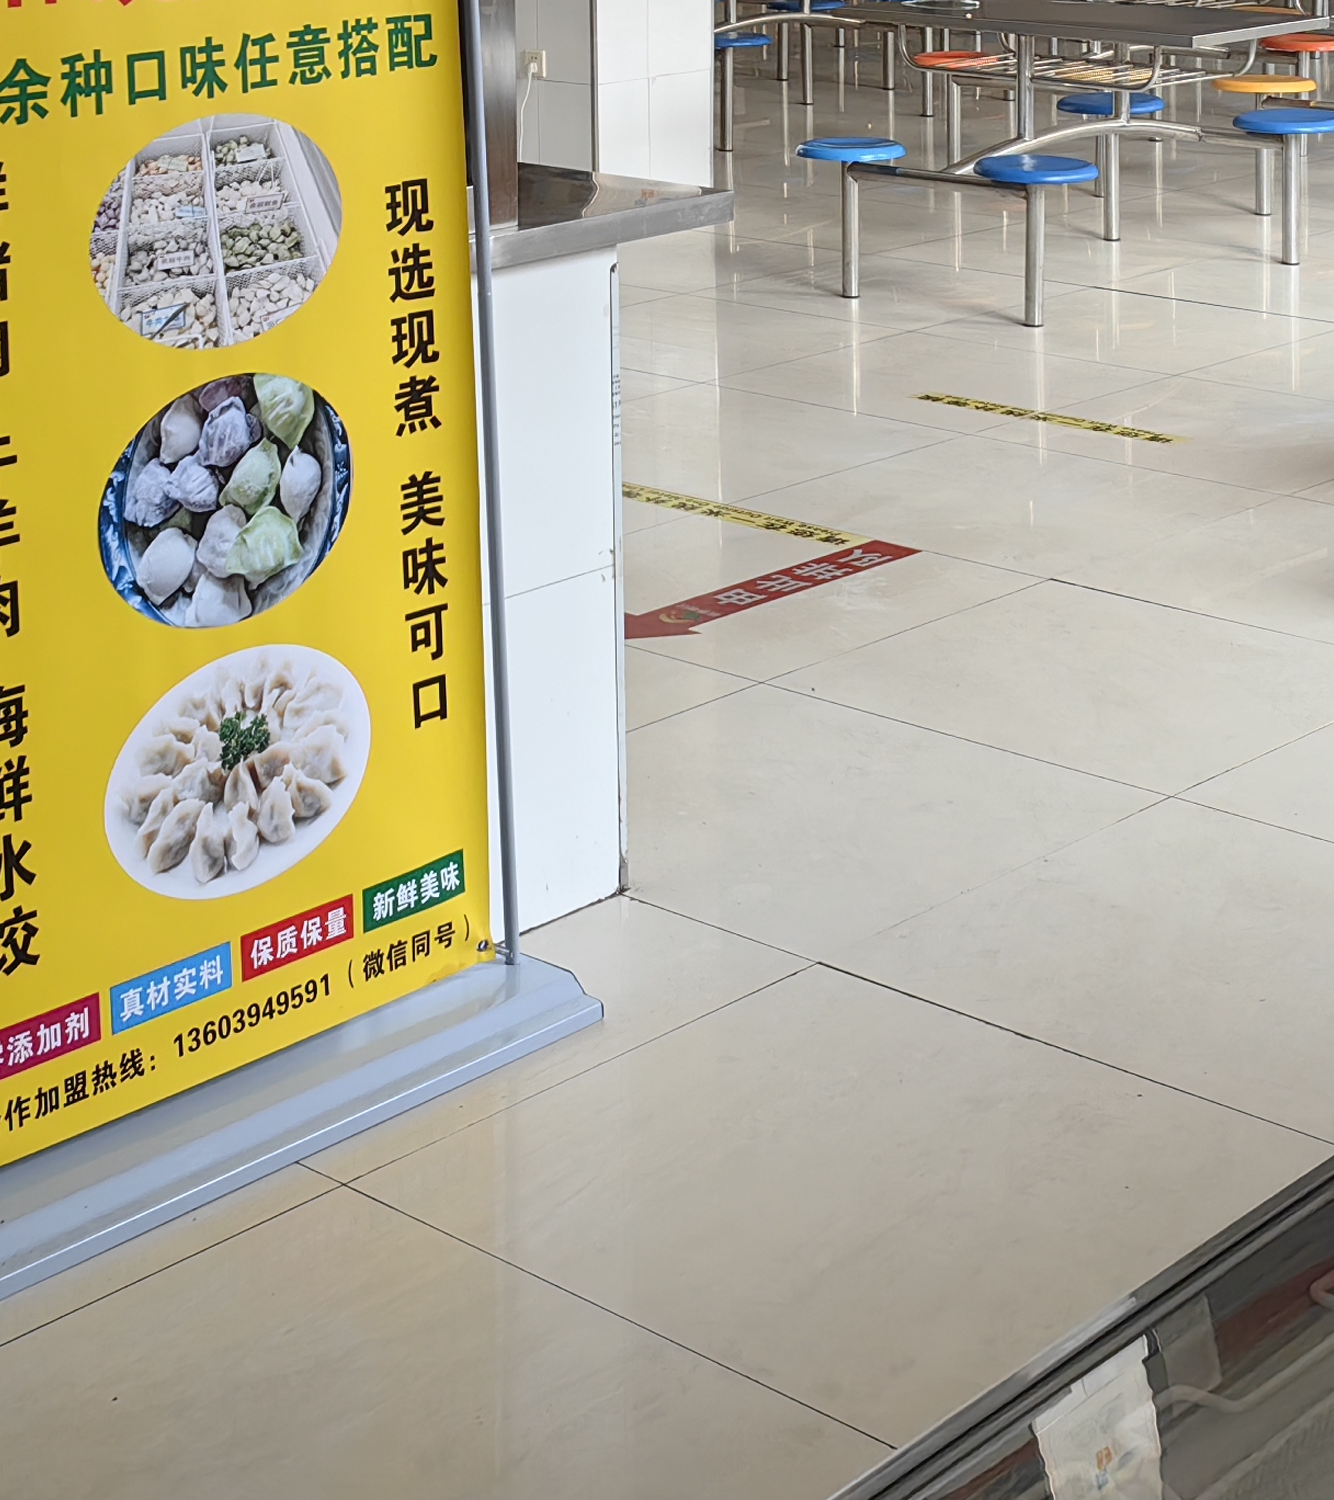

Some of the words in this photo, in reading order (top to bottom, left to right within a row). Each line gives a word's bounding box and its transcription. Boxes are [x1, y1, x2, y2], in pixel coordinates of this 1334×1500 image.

[384, 177, 442, 437] 现选现煮
[399, 469, 451, 730] 美味可口
[713, 549, 893, 606] 由此排队
[118, 959, 224, 1023] 真材实料
[250, 906, 347, 969] 保质保量
[372, 861, 460, 921] 新鲜美味
